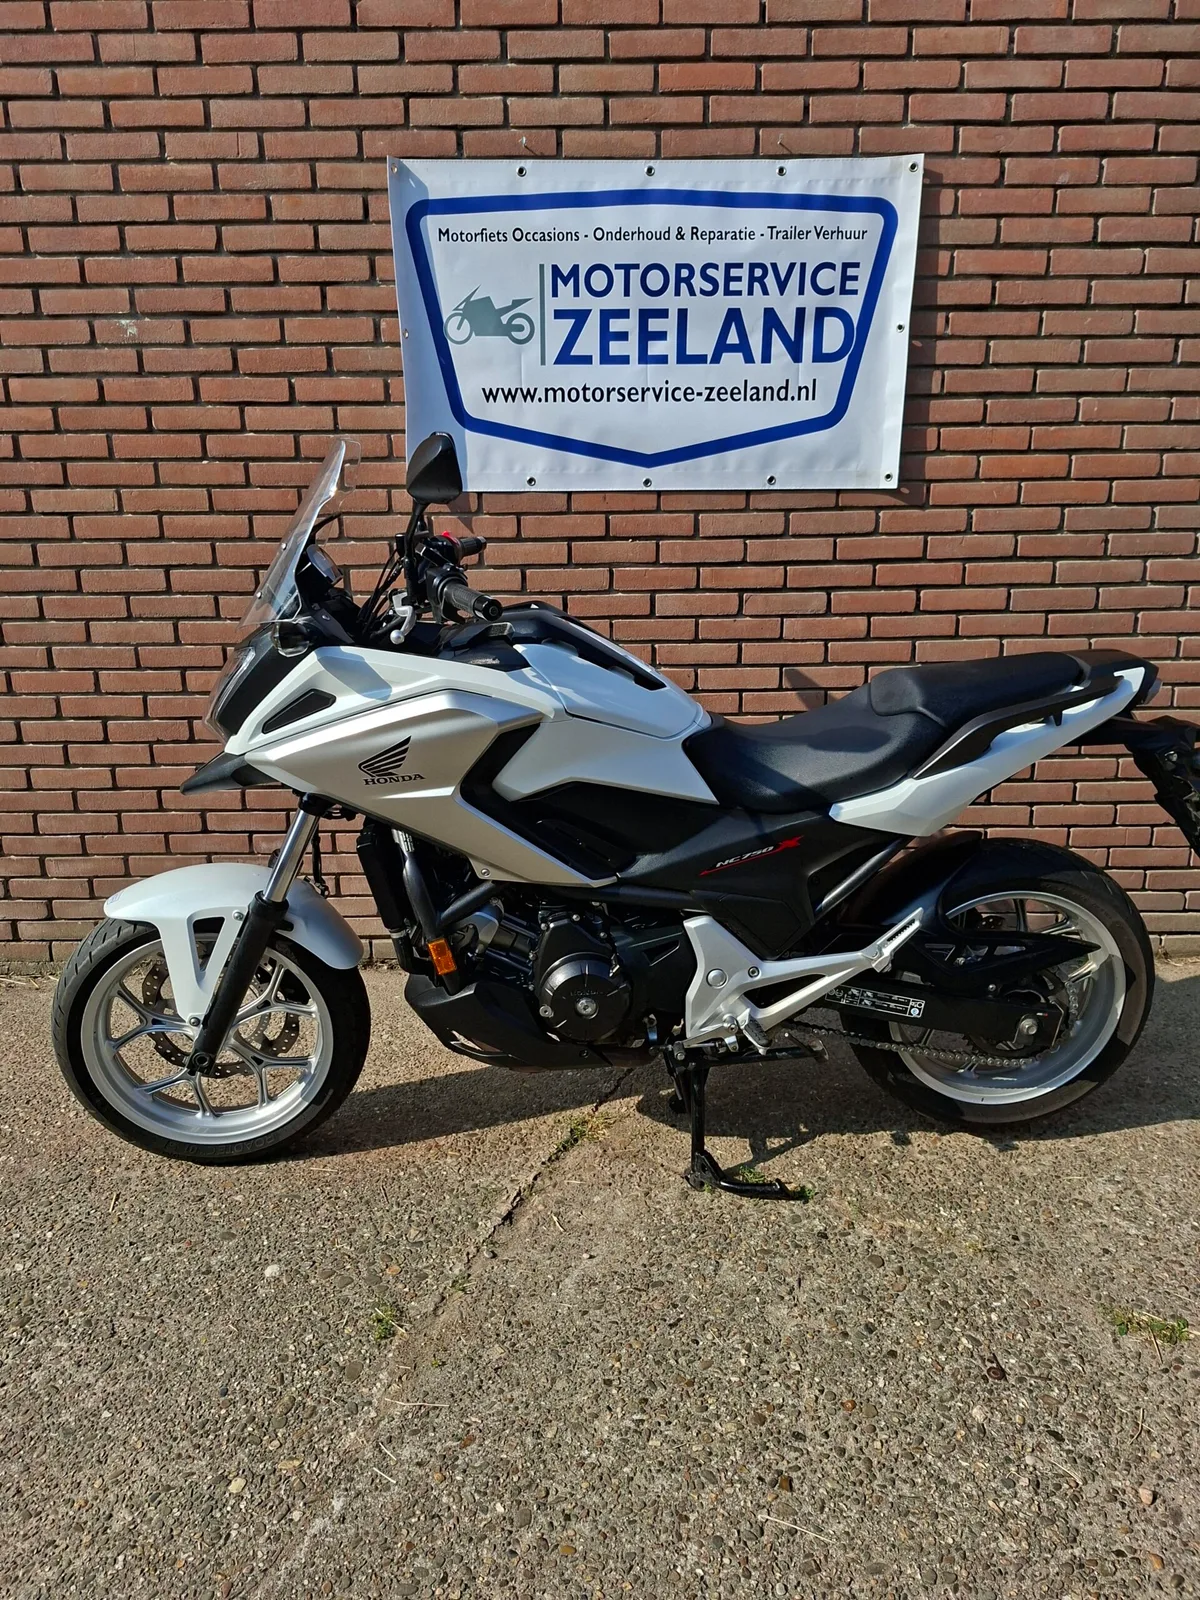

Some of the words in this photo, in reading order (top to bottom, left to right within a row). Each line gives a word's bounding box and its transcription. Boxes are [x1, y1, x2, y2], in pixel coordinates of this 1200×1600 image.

[438, 227, 508, 243] Motorfiets
[512, 227, 580, 242] Occasions
[593, 226, 671, 242] Onderhoud
[675, 227, 686, 241] &
[690, 226, 756, 245] Reparatie
[767, 225, 812, 240] Trailer
[813, 225, 868, 240] Verhuur
[550, 261, 861, 298] MOTORSERVICE
[552, 306, 856, 366] ZEELAND
[481, 378, 817, 403] www.motorservice-zeeland.nl
[362, 773, 426, 786] HONDA
